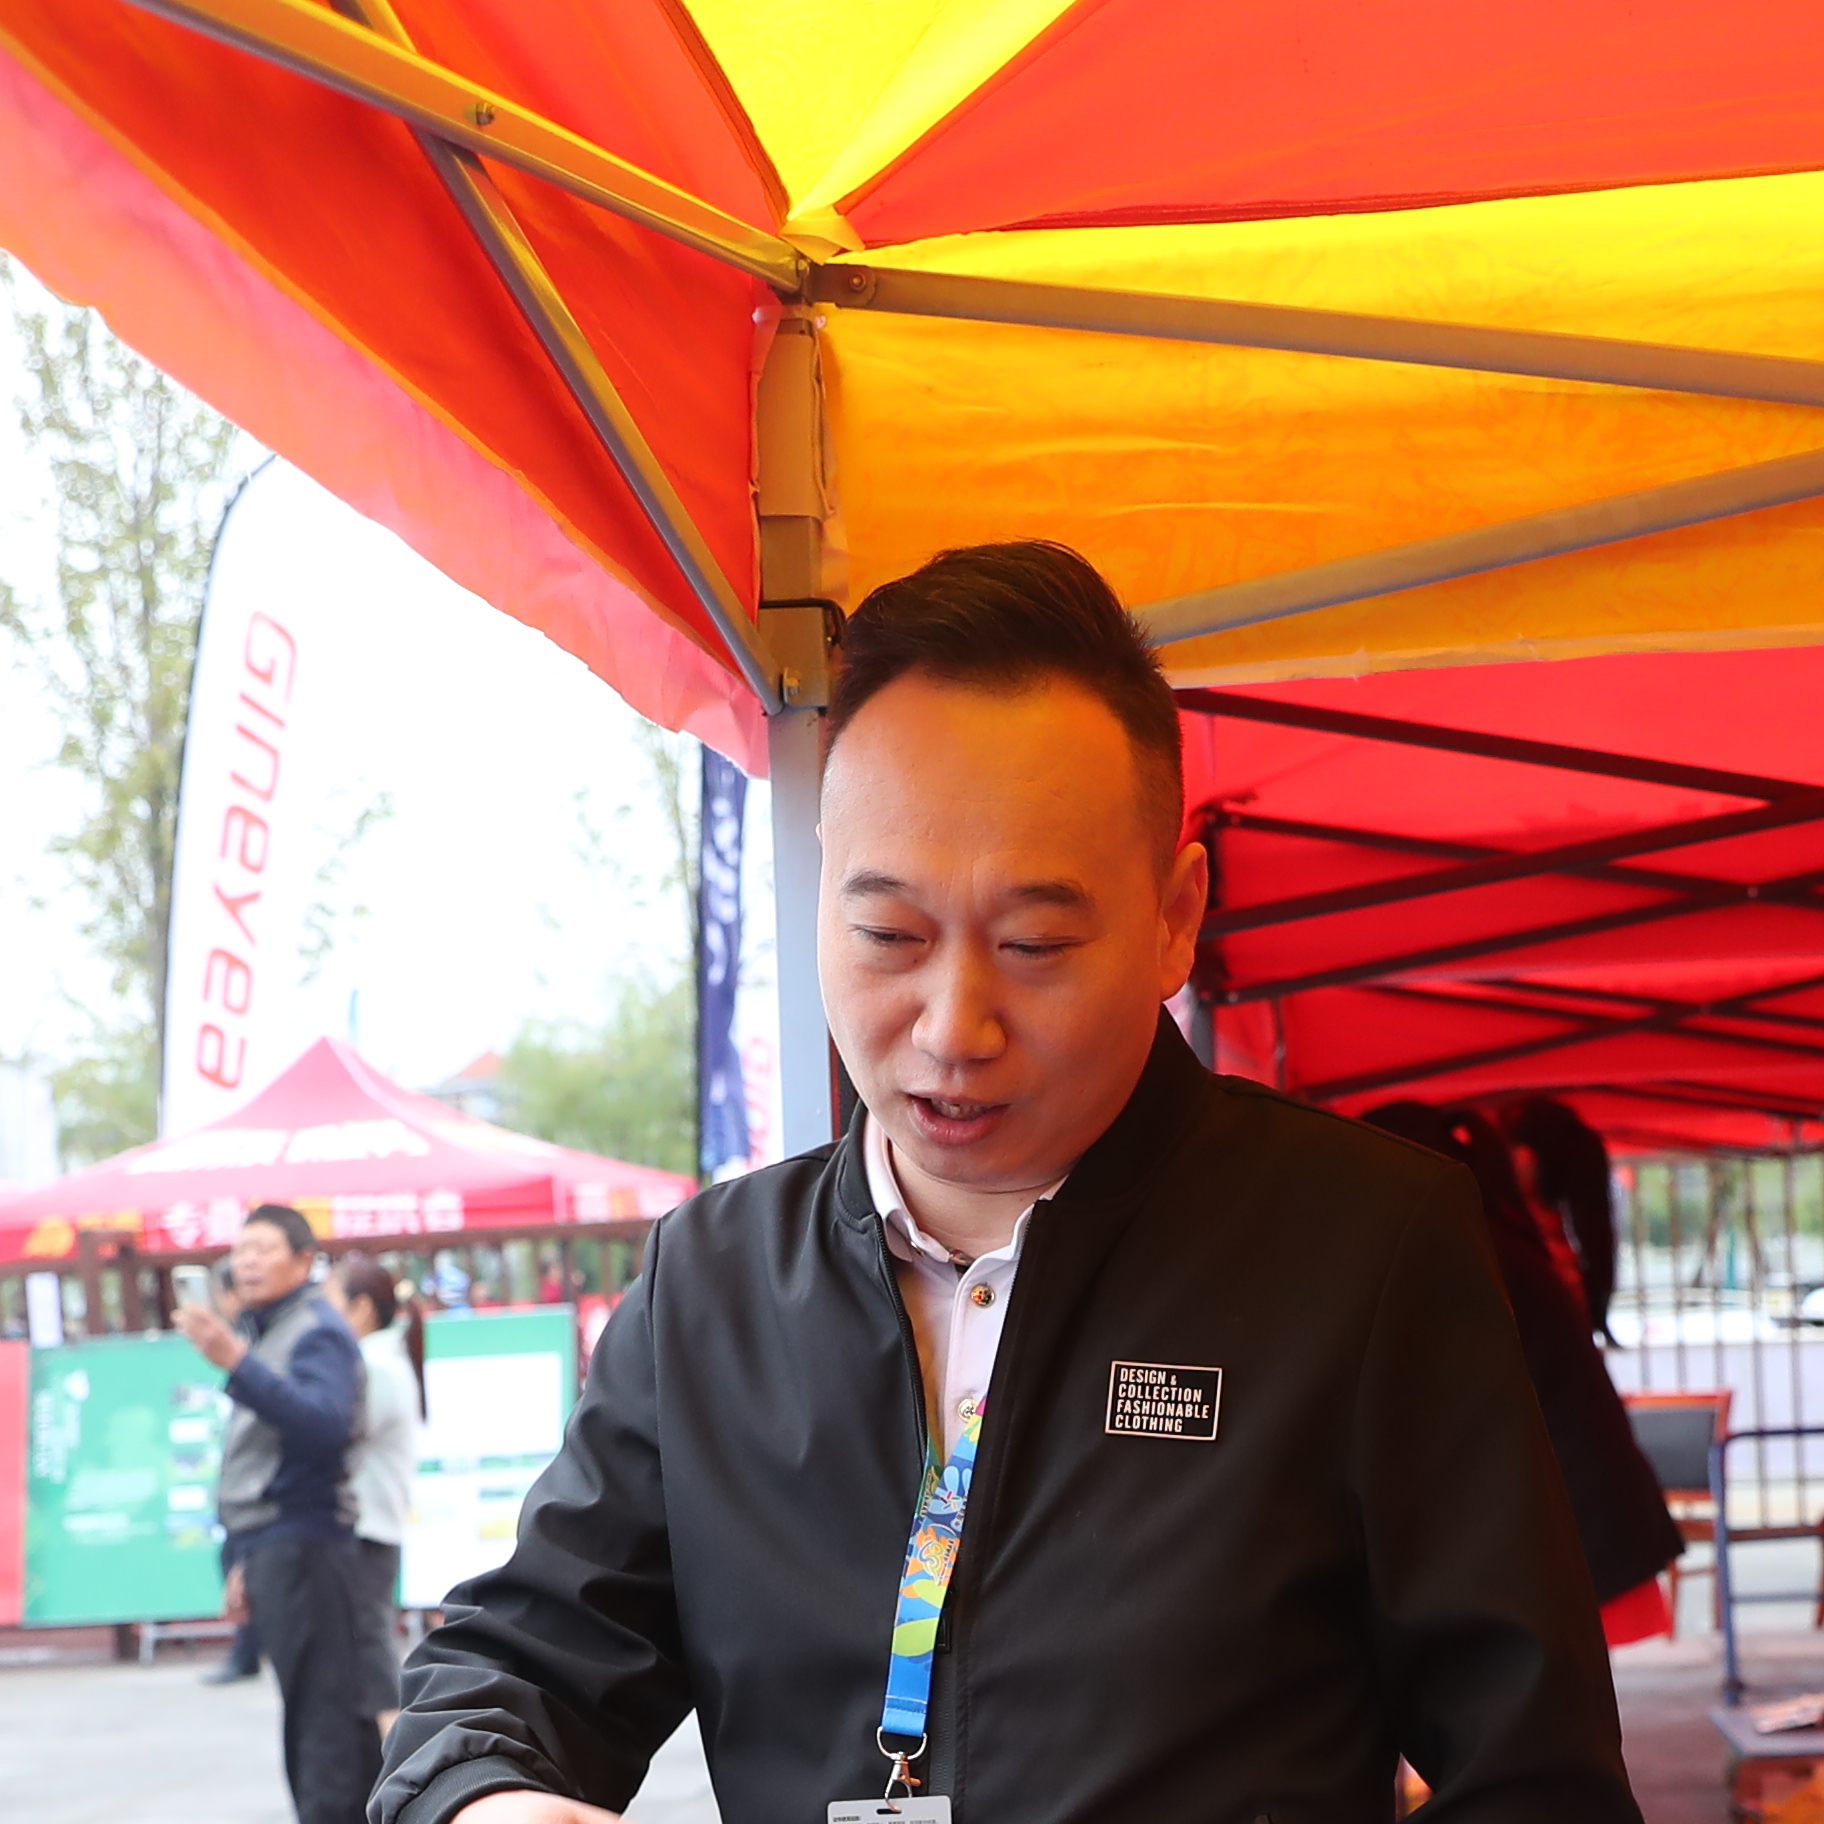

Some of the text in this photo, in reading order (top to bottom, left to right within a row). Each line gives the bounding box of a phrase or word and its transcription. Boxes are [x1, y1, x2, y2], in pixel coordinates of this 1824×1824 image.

[1120, 1368, 1177, 1386] DESIGN &
[1118, 1384, 1203, 1403] COLLECTION
[1116, 1399, 1210, 1419] FASHIONABLE
[1114, 1414, 1183, 1433] CLOTHING
